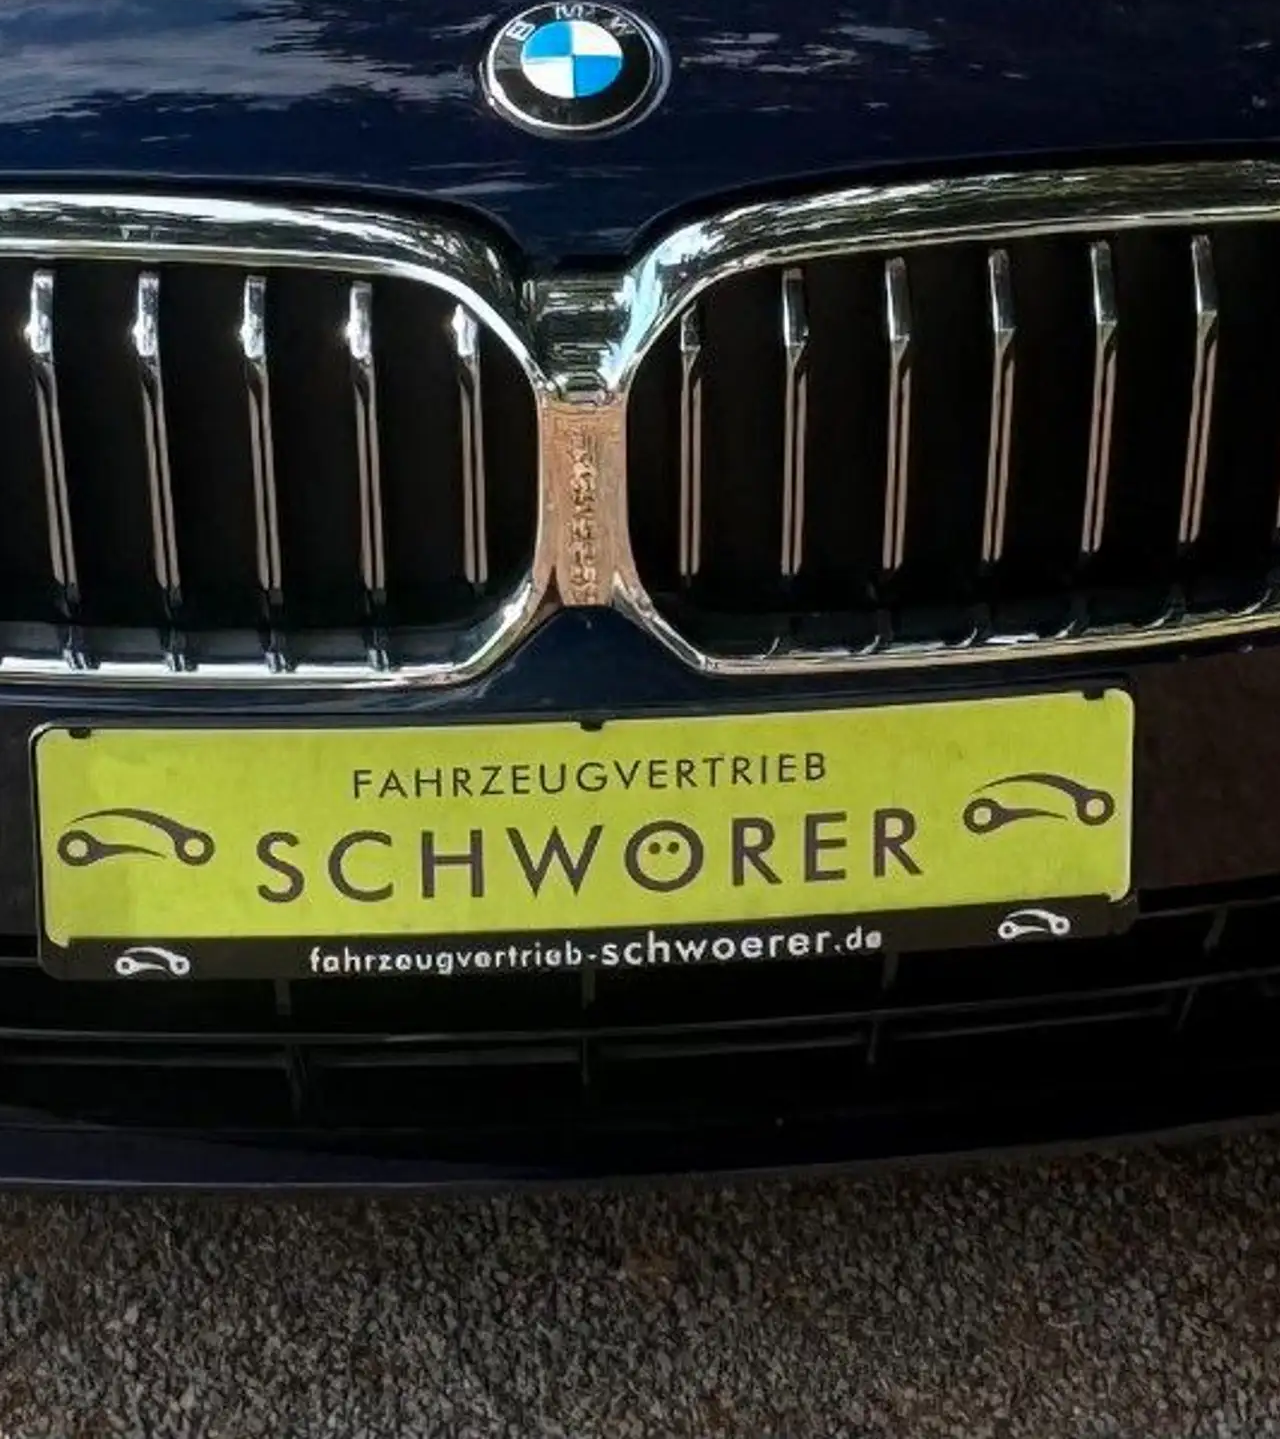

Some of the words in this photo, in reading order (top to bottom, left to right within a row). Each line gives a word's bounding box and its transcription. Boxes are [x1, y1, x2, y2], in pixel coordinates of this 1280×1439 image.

[506, 3, 636, 42] BMW
[352, 752, 827, 799] FAHRZEUGVERTRIEB
[256, 807, 924, 903] SCHWÖRER
[309, 925, 883, 975] fahrzeugvertrieb-schwoerer.de
